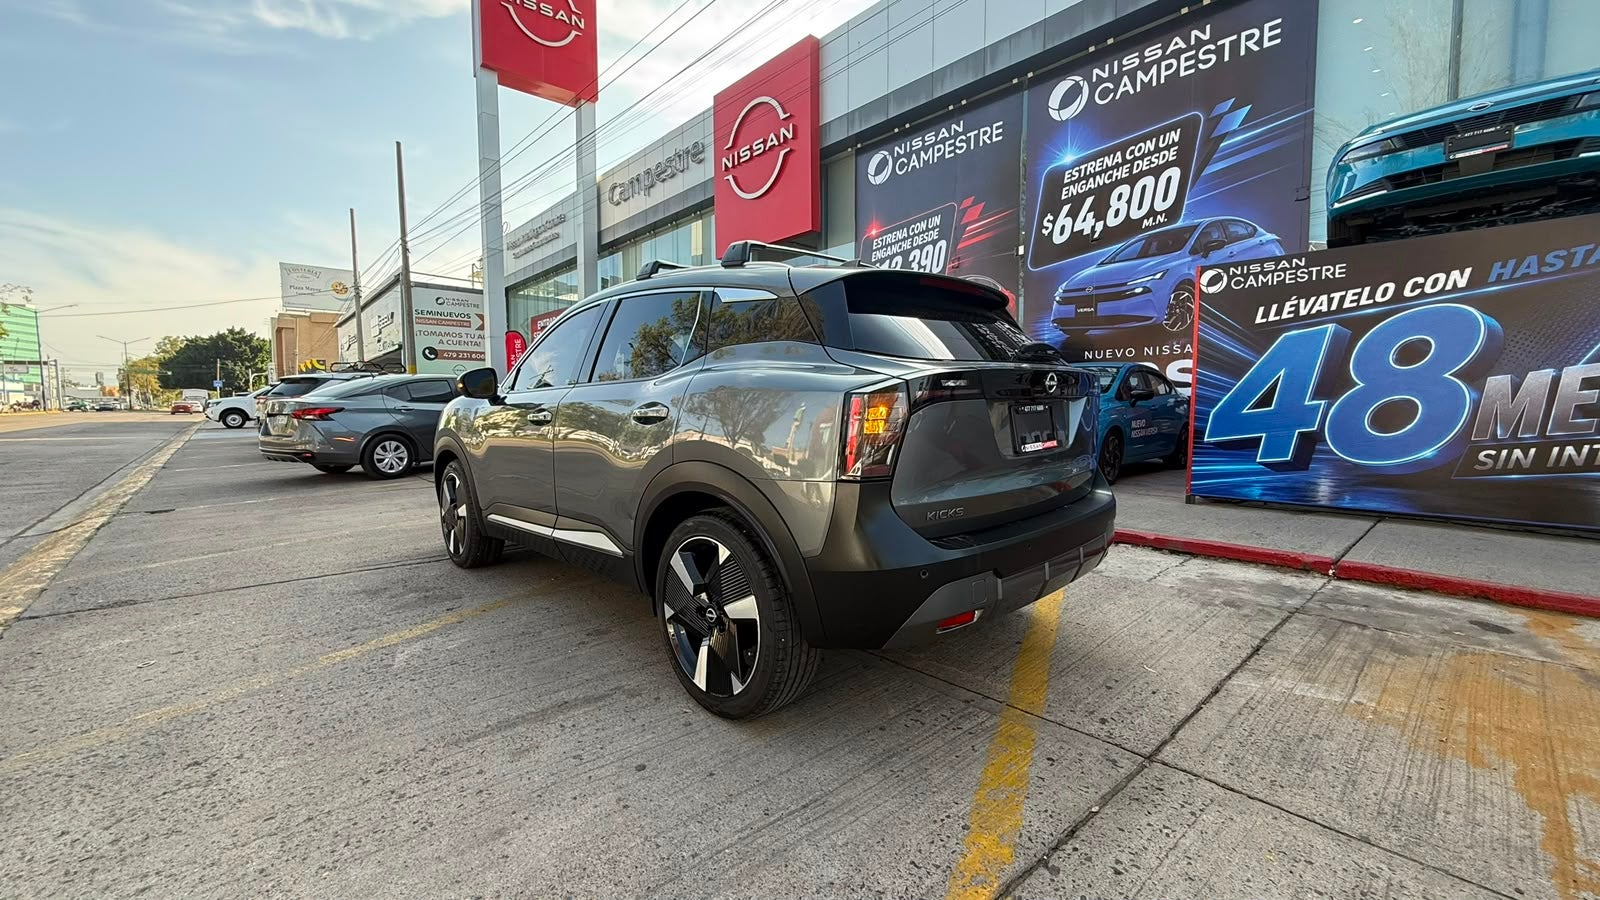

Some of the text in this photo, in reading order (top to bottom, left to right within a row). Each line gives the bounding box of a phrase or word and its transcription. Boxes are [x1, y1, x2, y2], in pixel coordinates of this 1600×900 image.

[510, 0, 584, 29] SSAN
[1092, 24, 1211, 83] NISSAN
[1094, 18, 1282, 105] CAMPESTRE
[721, 124, 793, 171] NISSAN
[894, 120, 964, 158] NISSAN
[895, 121, 1004, 175] CAMPESTRE
[1063, 128, 1181, 184] ESTRENA CON UN
[608, 141, 705, 206] Campestre
[1061, 146, 1179, 200] ENGANCHE DESDE
[1041, 167, 1181, 245] $64,800
[1142, 213, 1168, 229] M.N.
[871, 228, 939, 262] ENGANCHE DESDE
[872, 214, 942, 250] ESTRENA CON UN
[1229, 257, 1306, 276] NISSAN
[1230, 264, 1347, 290] CAMPESTRE
[414, 309, 472, 319] SEMINUEVOS
[1254, 281, 1396, 325] LLÉVATELO
[1403, 266, 1473, 297] CON
[437, 319, 470, 327] CAMPESTRE
[1084, 344, 1193, 359] NUEVO NISSA
[1204, 303, 1494, 468] 48
[1471, 363, 1600, 440] ME
[1473, 448, 1537, 470] SIN
[927, 507, 964, 520] KICKS
